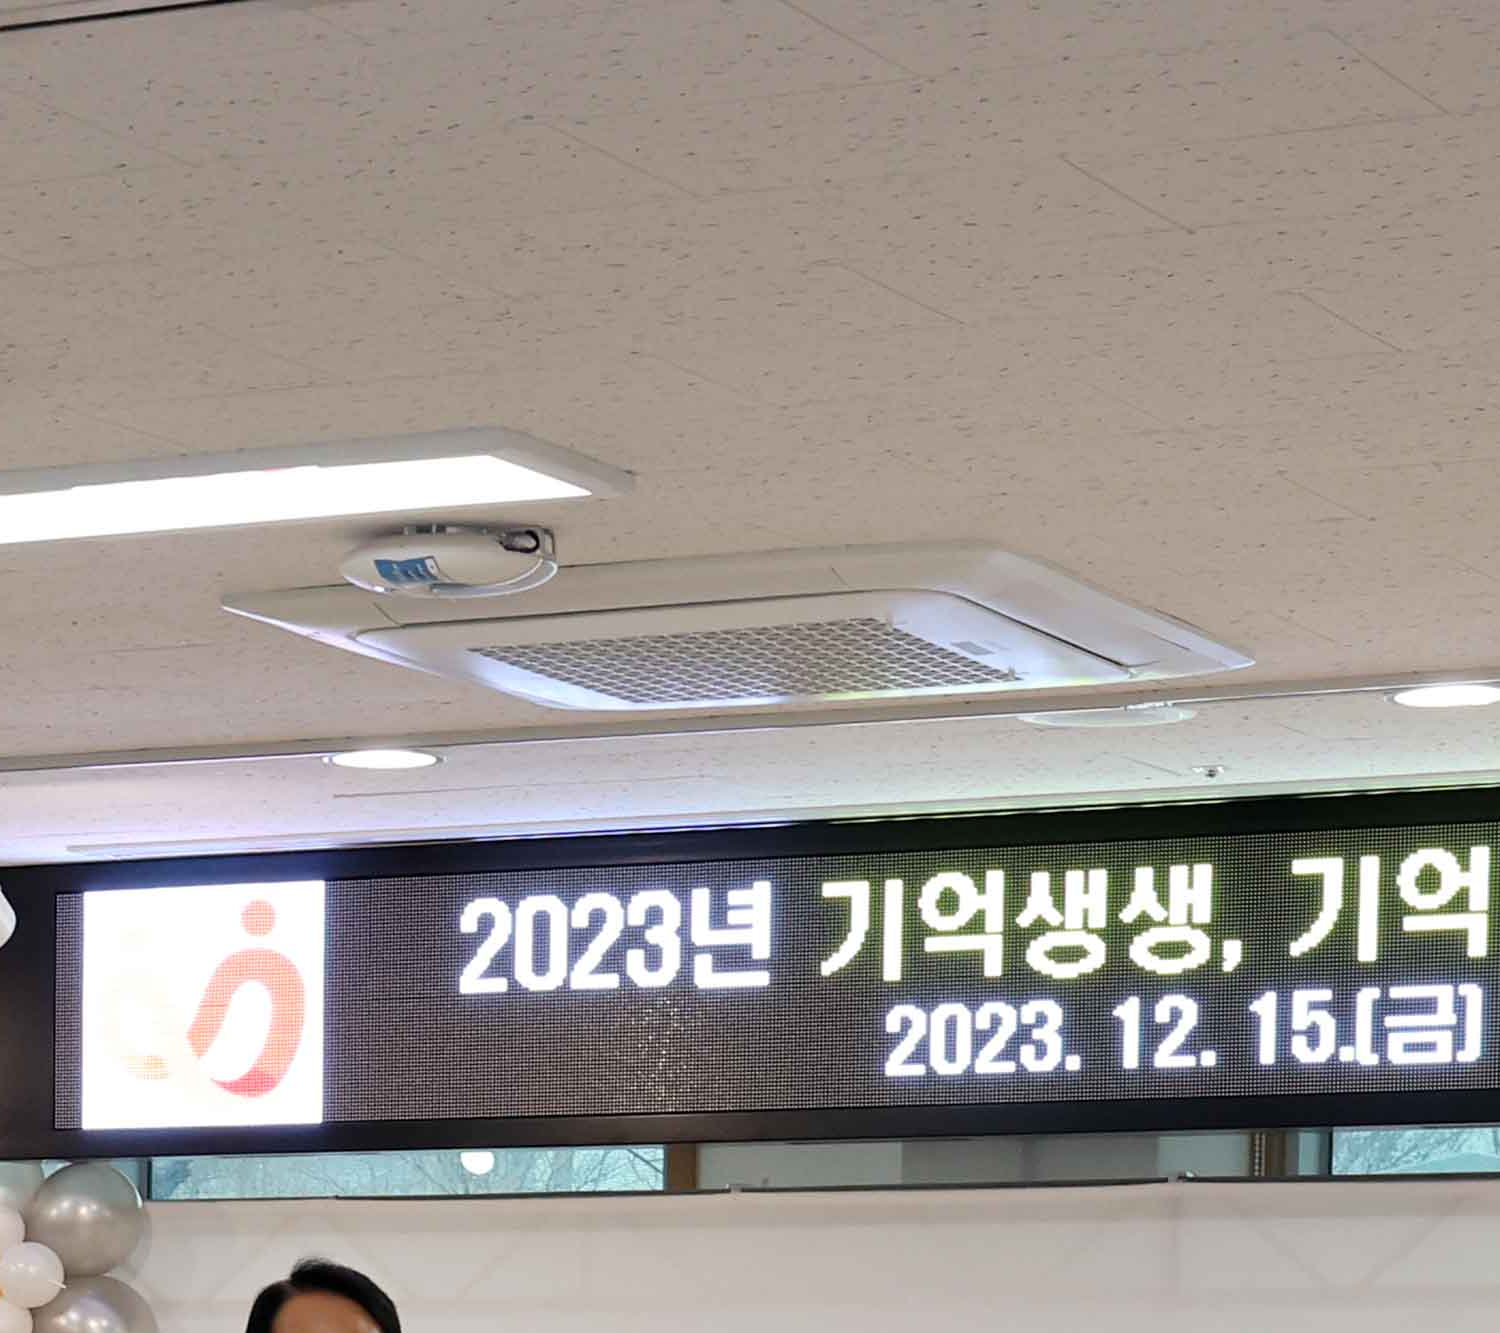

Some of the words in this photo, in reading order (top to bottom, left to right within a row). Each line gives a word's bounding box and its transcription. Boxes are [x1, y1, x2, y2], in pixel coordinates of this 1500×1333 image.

[457, 880, 772, 995] 2023년
[820, 862, 1242, 982] 기억생생,
[884, 999, 1081, 1077] 2023.
[1113, 994, 1217, 1069] 12.
